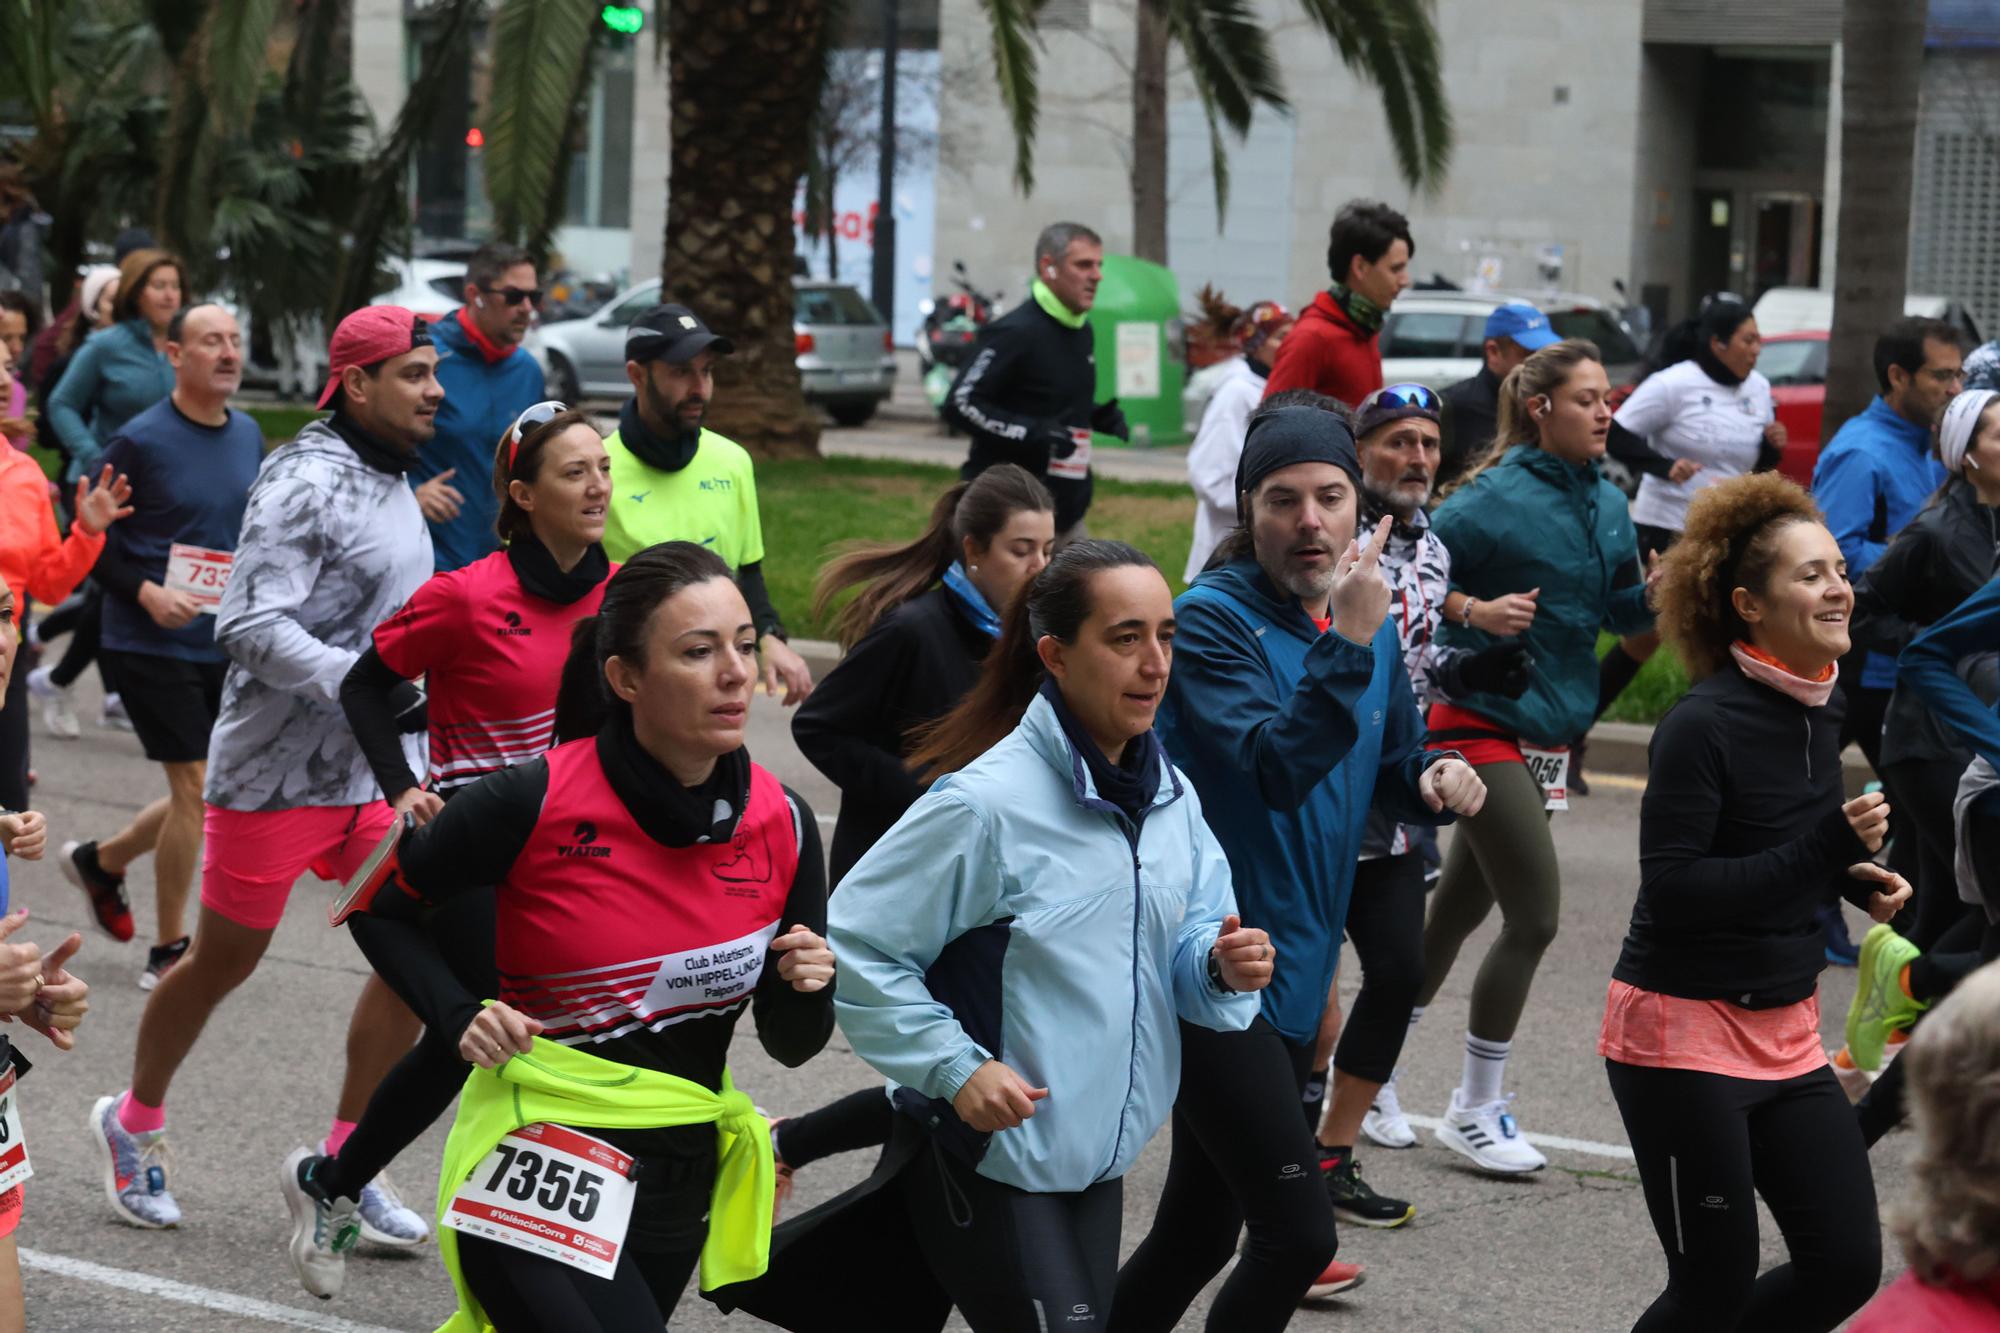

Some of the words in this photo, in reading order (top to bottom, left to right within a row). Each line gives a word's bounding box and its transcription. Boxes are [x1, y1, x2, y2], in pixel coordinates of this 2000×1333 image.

[1526, 755, 1563, 783] 056
[558, 846, 610, 857] VIATOR
[685, 956, 709, 970] Club
[713, 945, 754, 966] Atletismo
[666, 976, 693, 990] VON
[485, 1144, 605, 1222] 7355
